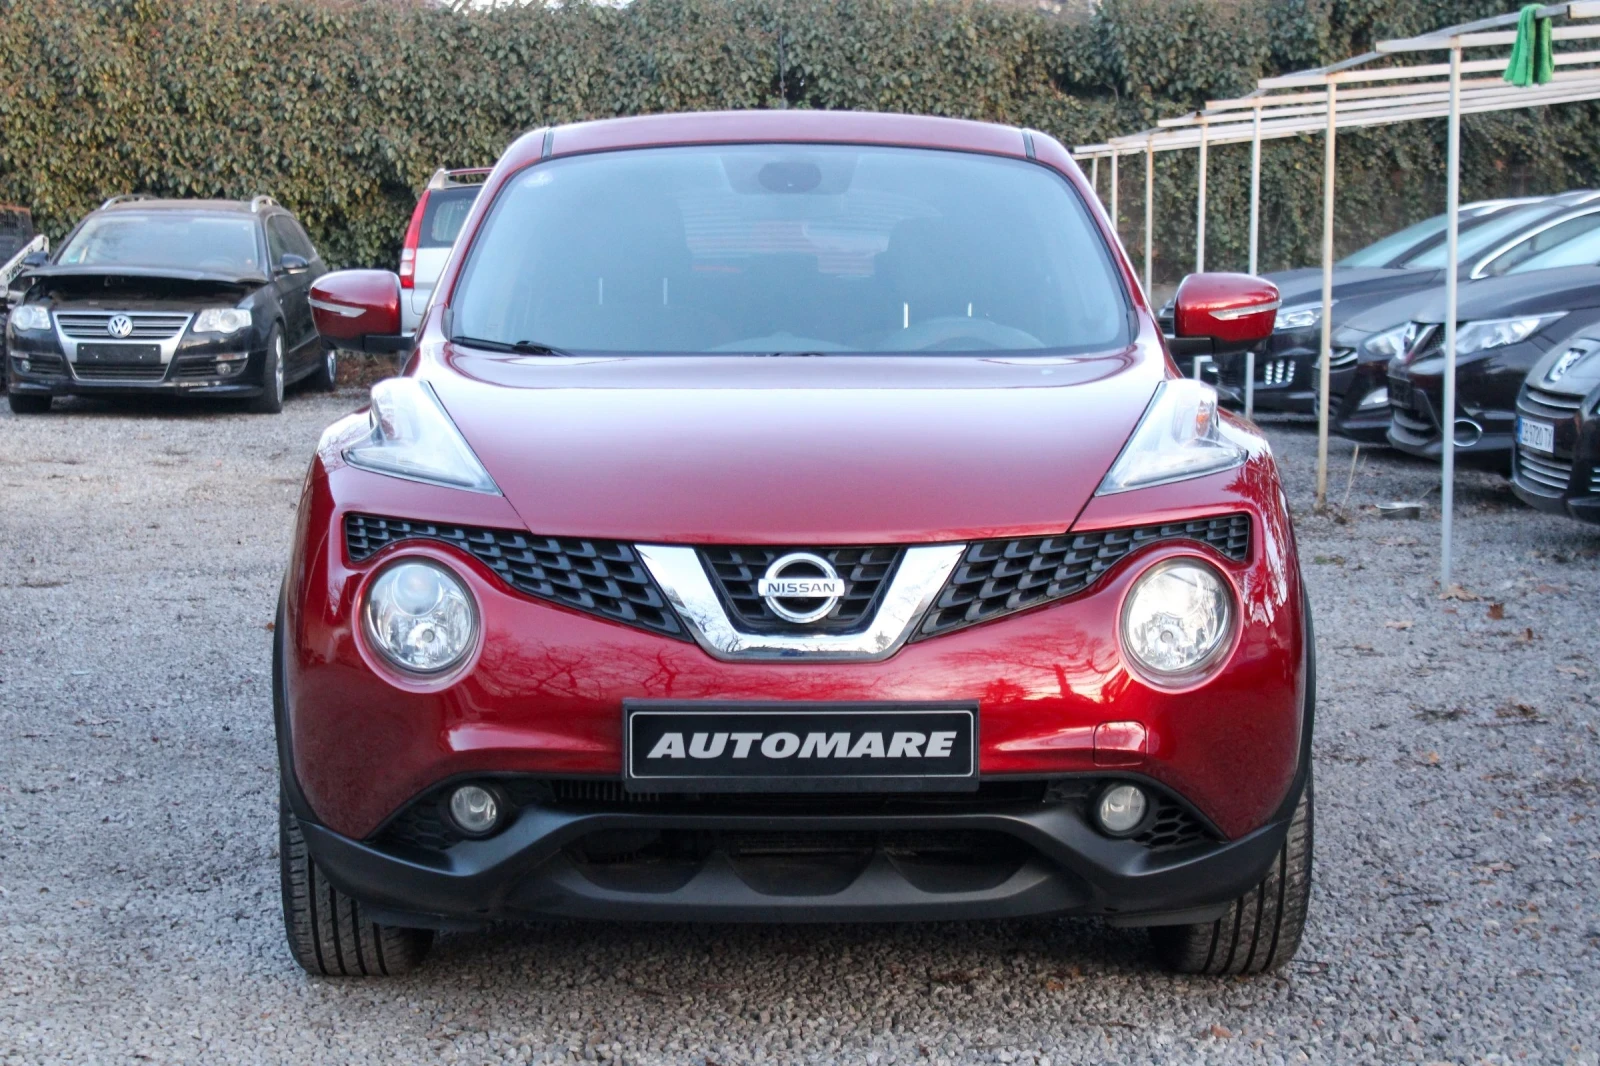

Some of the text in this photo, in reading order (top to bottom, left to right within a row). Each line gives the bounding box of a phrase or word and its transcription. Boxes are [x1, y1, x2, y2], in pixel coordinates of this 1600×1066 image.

[109, 315, 132, 337] VW
[768, 583, 835, 593] NISSAN
[647, 731, 957, 759] AUTOMARE
